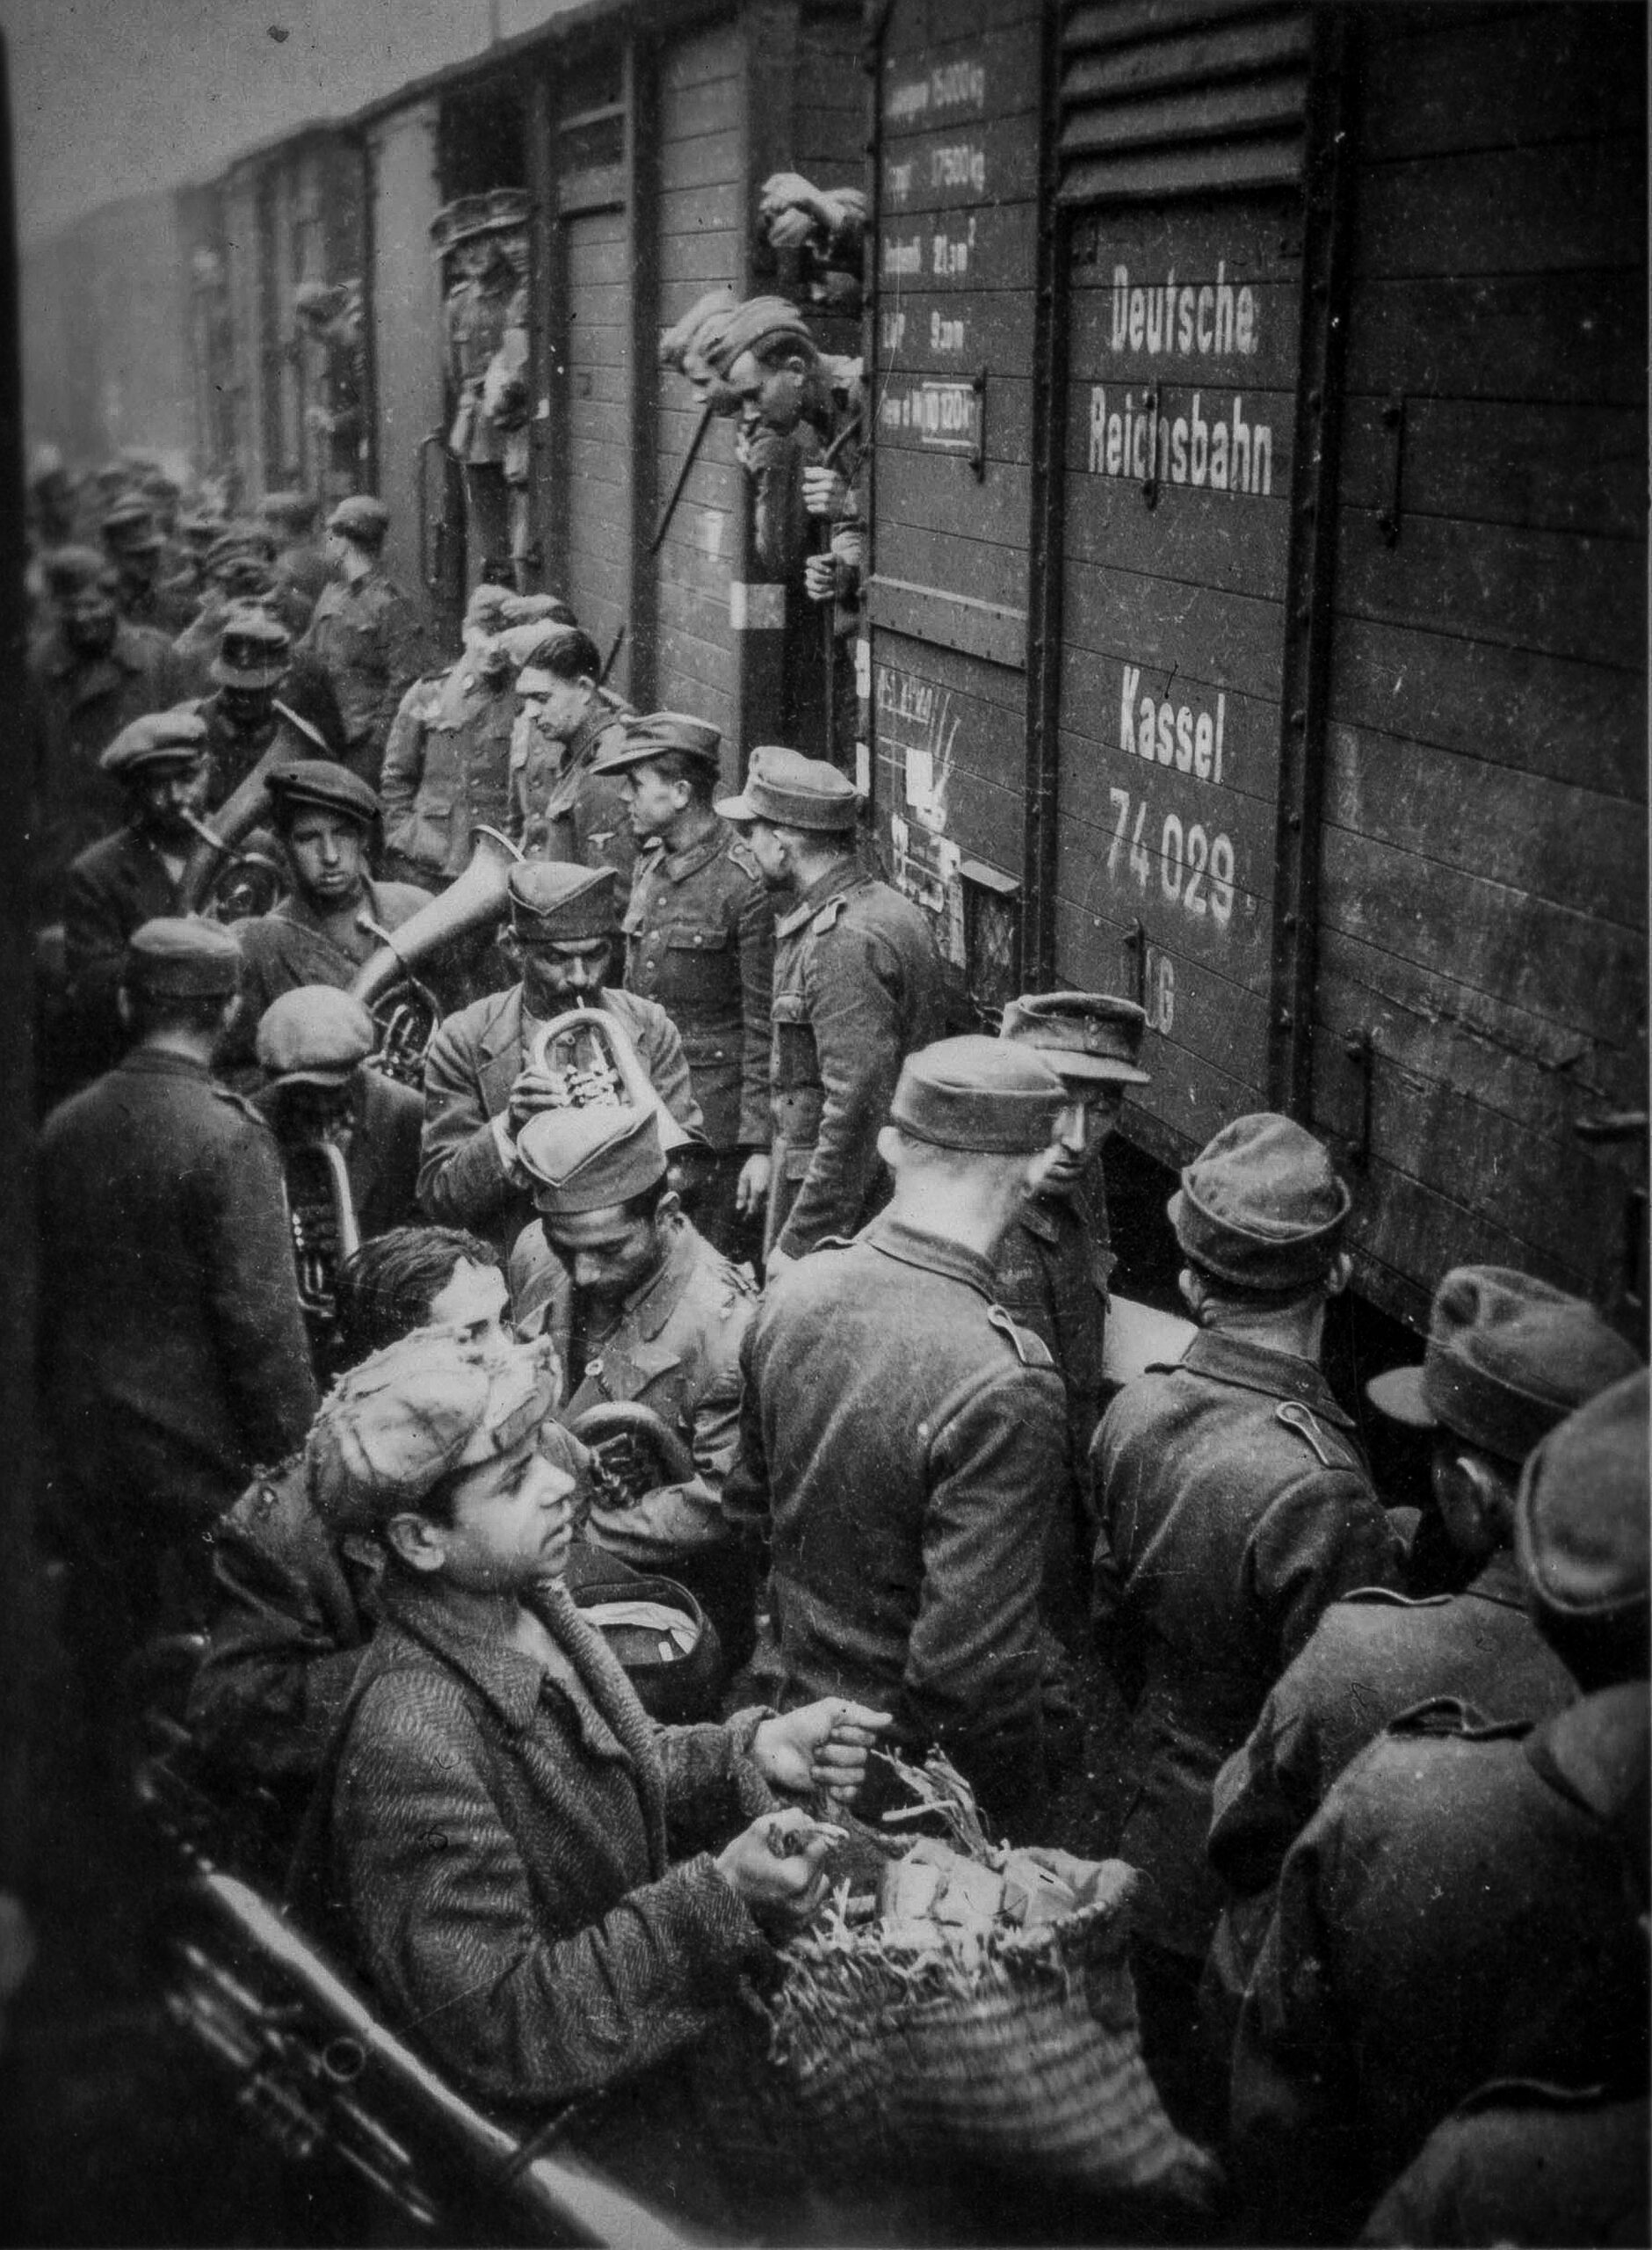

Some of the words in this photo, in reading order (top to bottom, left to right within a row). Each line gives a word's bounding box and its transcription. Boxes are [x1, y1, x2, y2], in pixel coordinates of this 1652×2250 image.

[1111, 261, 1257, 353] Deutsche
[1089, 387, 1272, 495] Reichsbahn
[1120, 665, 1226, 783] Kassel
